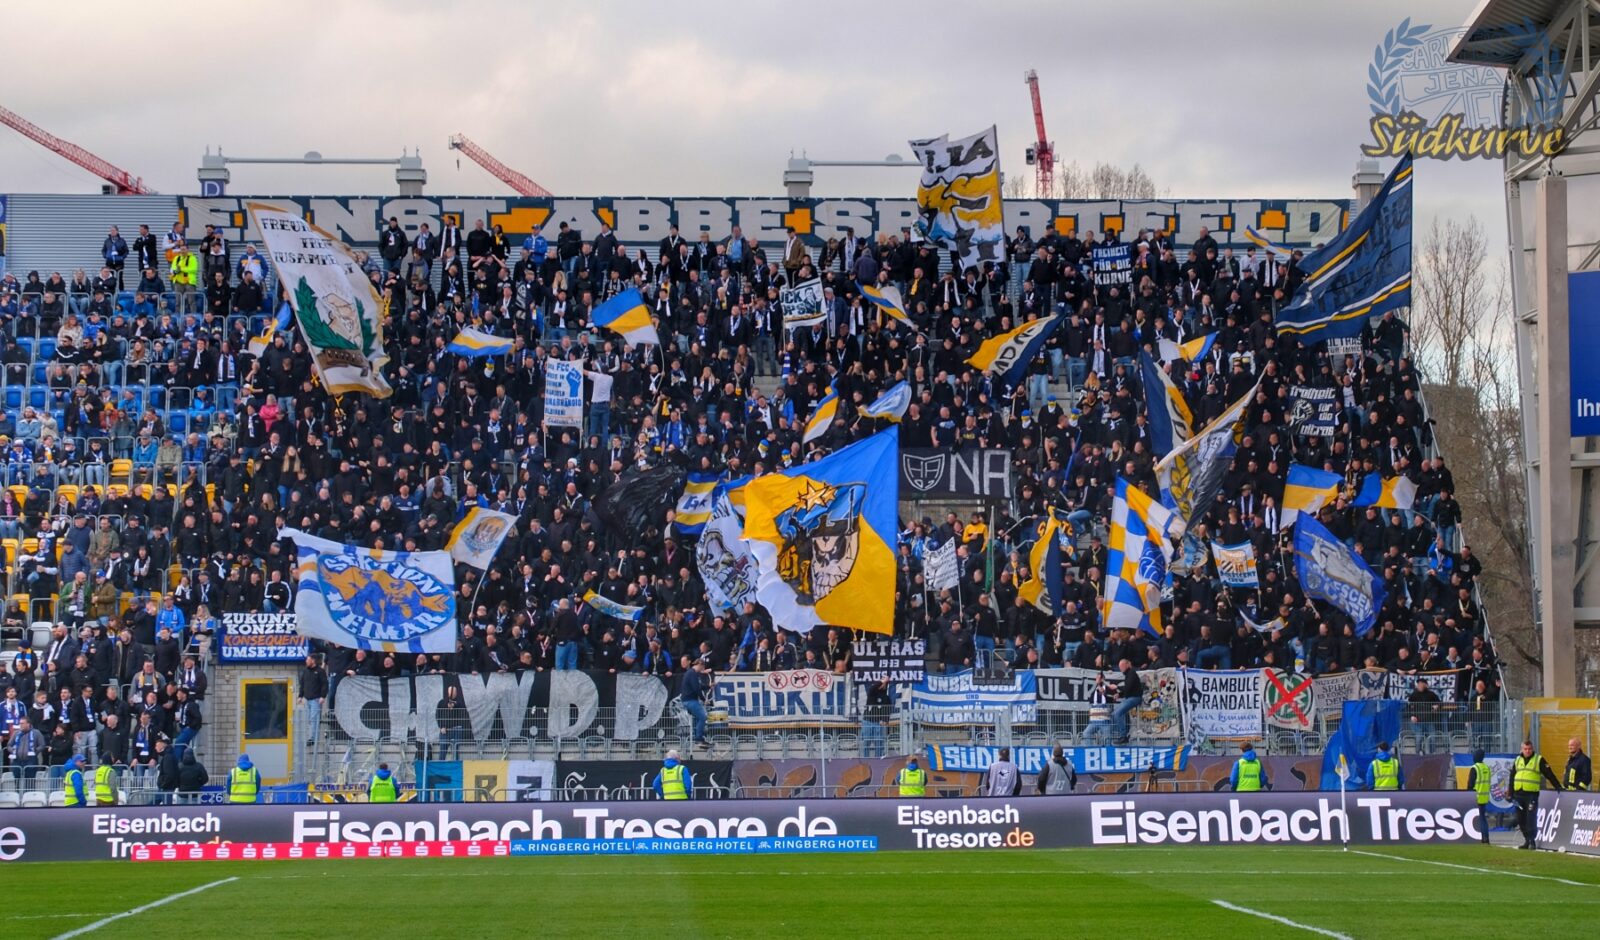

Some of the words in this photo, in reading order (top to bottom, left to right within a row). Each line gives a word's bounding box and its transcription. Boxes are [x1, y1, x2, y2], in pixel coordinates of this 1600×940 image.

[815, 200, 1342, 245] SPRTFELD
[1093, 245, 1129, 258] FREIHEIT
[1093, 259, 1111, 271] FÜR
[1116, 258, 1131, 270] DIE
[1094, 270, 1132, 285] KURVE
[324, 554, 442, 594] SEKTION
[327, 591, 446, 640] WEIMAR
[222, 646, 309, 657] UMSETZEN
[850, 641, 925, 656] ULTRAS
[854, 671, 924, 682] LAUSANNE
[1201, 677, 1260, 692] BAMBULE
[1202, 693, 1260, 710] RANDALE
[1085, 748, 1172, 771] BLEIBT
[897, 804, 1020, 825] Eisenbach
[1091, 799, 1350, 844] Eisenbach
[93, 813, 221, 835] Eisenbach
[293, 809, 563, 843] Eisenbach
[651, 841, 713, 851] RINGBERG
[716, 840, 754, 850] HOTEL
[774, 840, 835, 849] RINGBERG
[838, 839, 876, 849] HOTEL
[912, 827, 1035, 848] Tresore.de
[528, 843, 590, 852] RINGBERG
[593, 842, 631, 851] HOTEL
